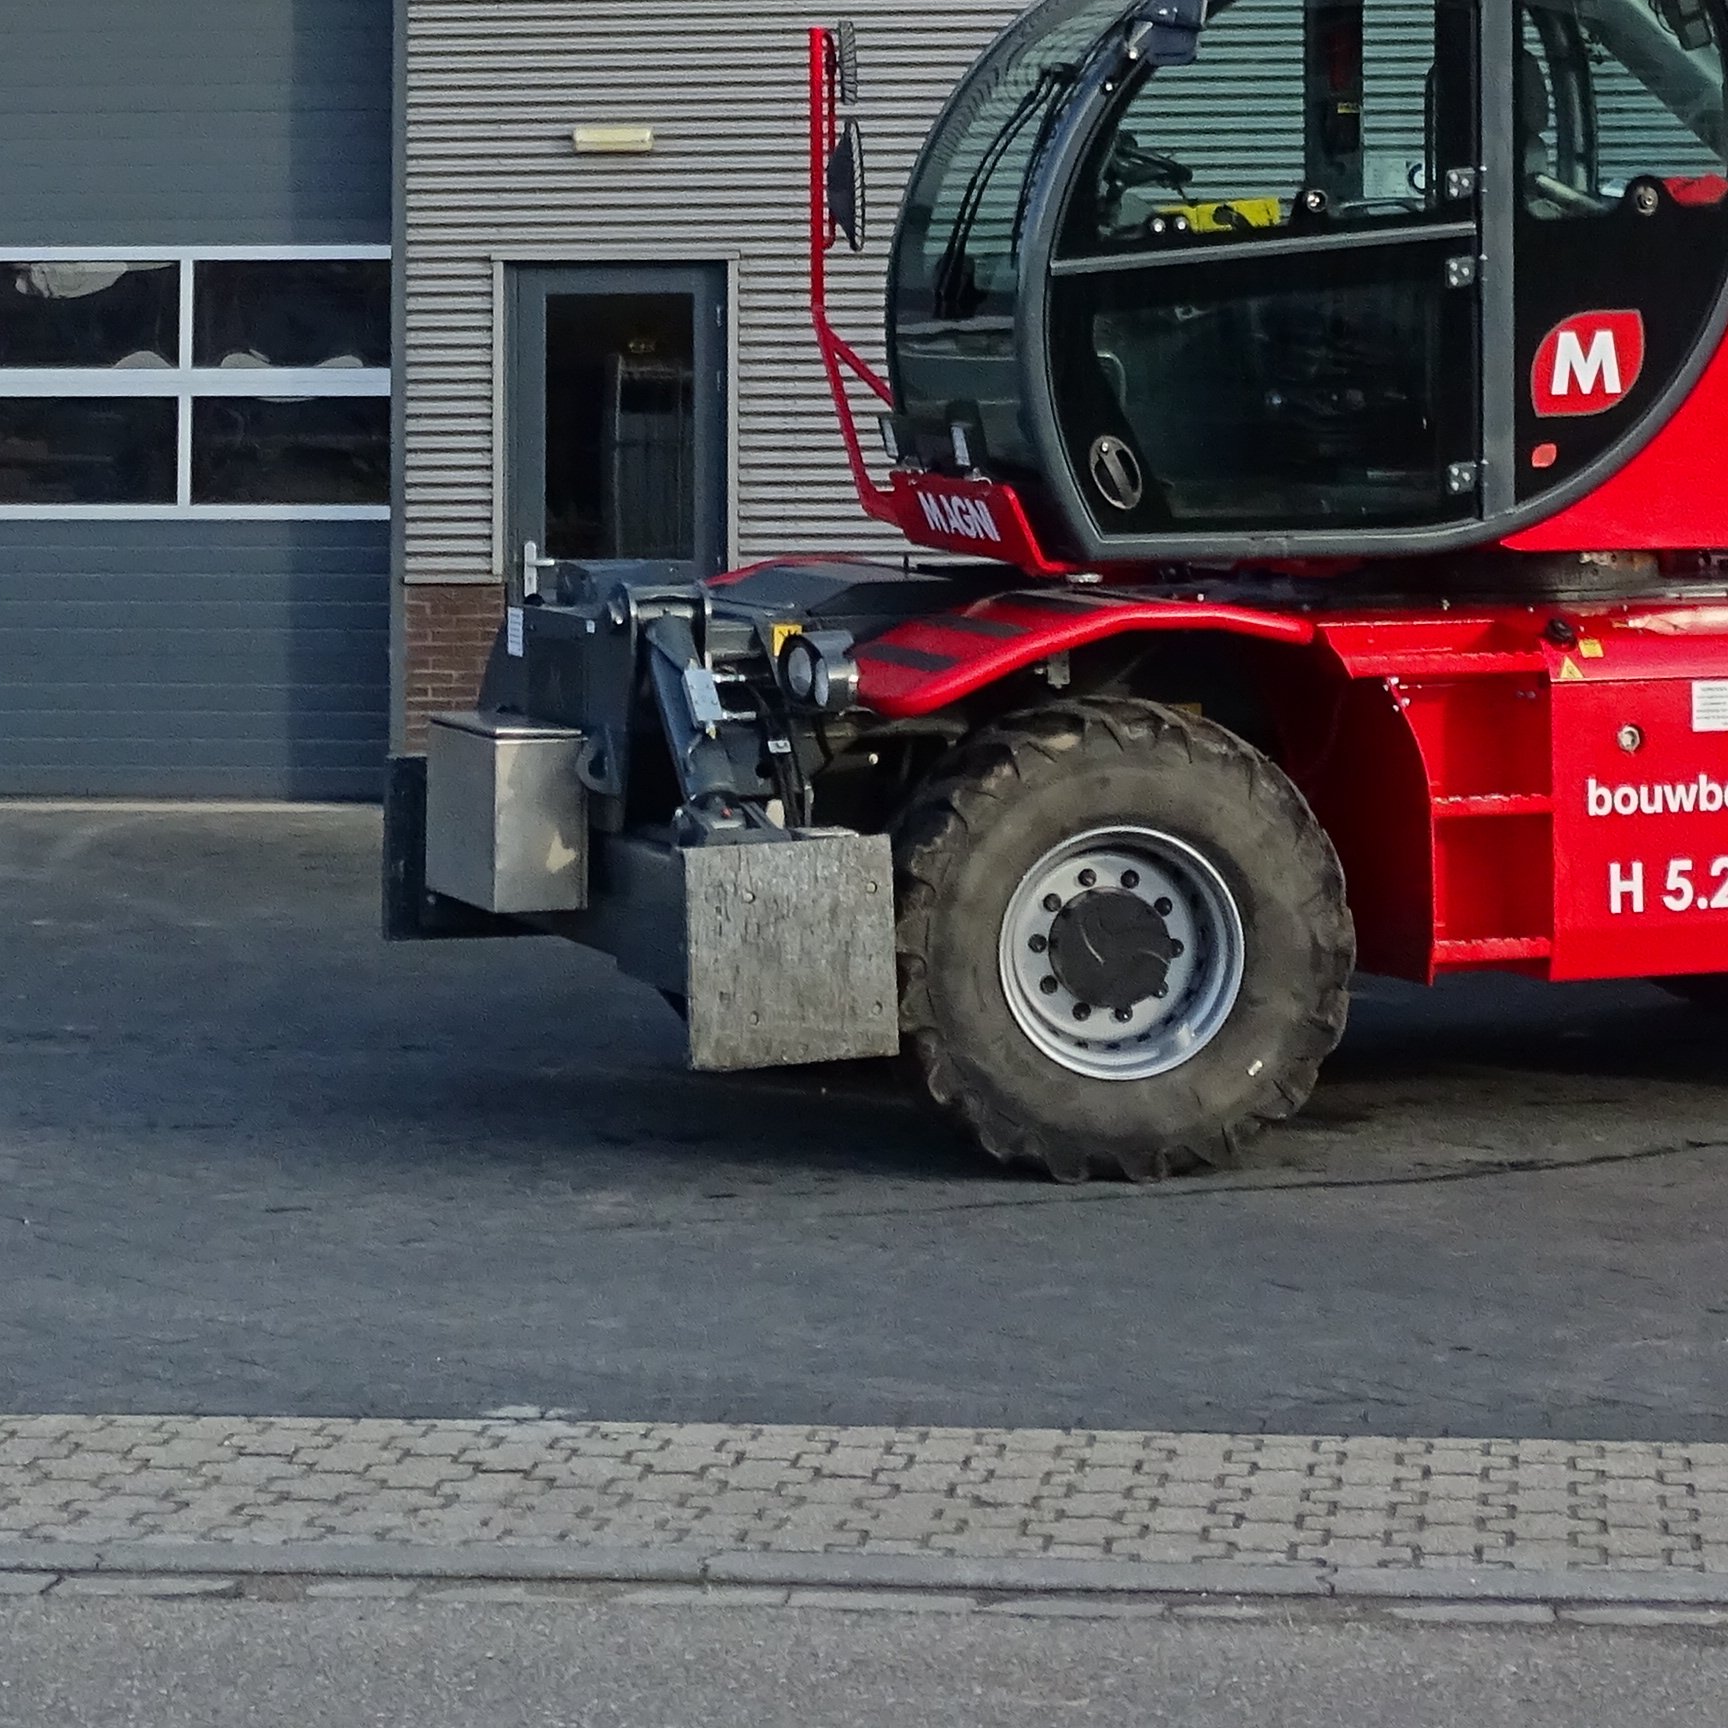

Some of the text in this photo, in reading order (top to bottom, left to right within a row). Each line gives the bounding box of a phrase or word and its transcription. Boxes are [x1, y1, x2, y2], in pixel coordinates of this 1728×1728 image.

[1551, 329, 1622, 396] M
[917, 491, 1001, 542] MAGNI
[1608, 861, 1644, 914] H
